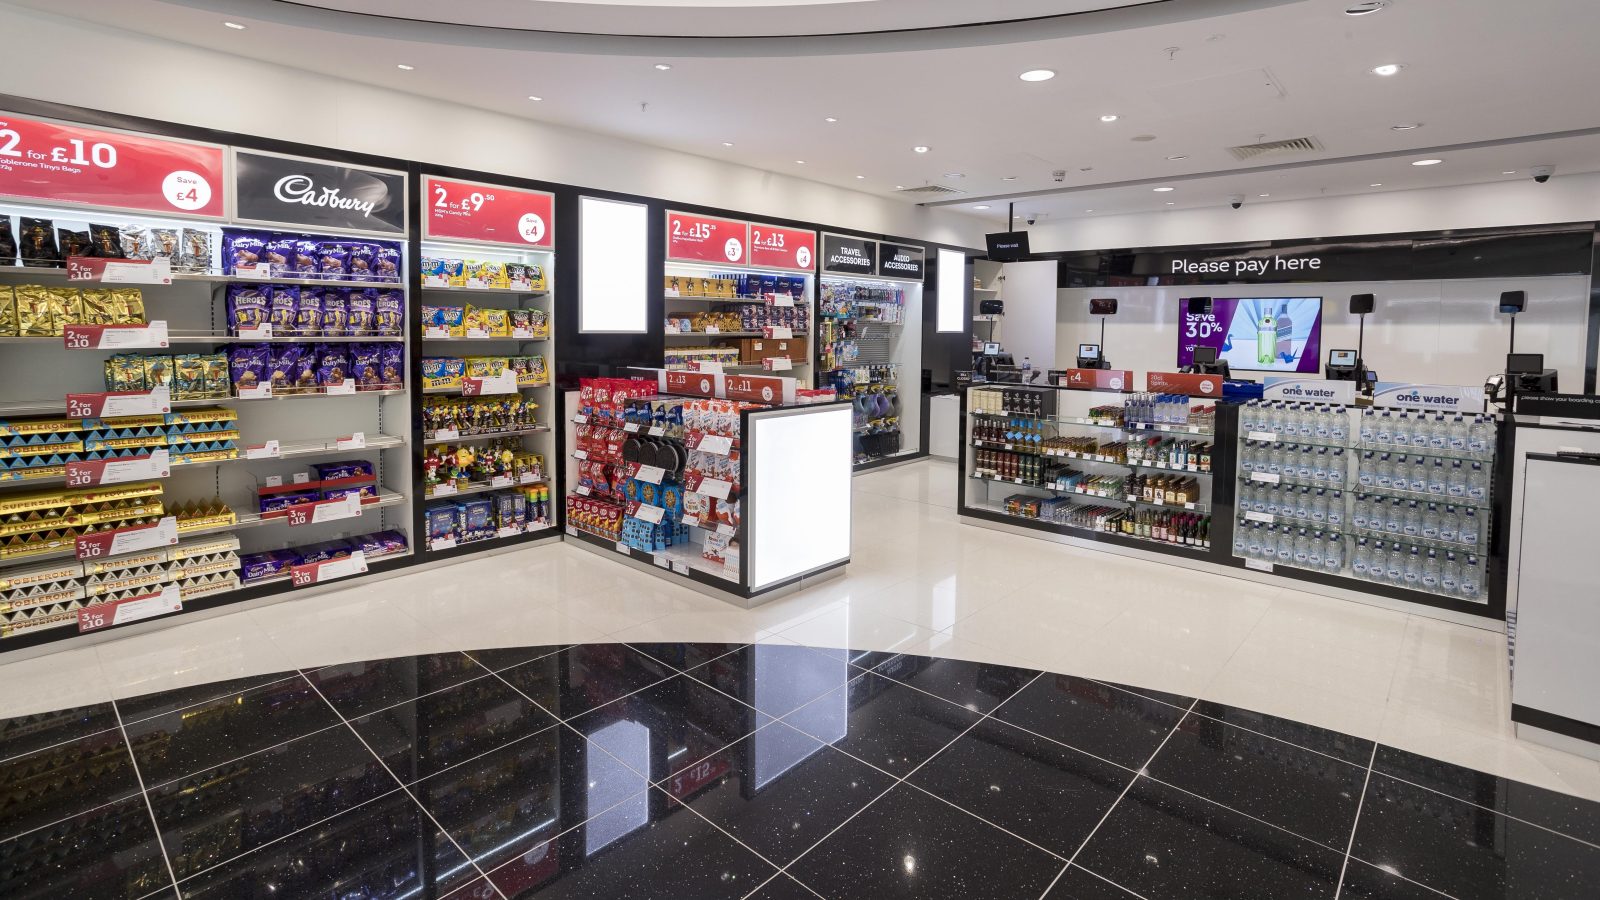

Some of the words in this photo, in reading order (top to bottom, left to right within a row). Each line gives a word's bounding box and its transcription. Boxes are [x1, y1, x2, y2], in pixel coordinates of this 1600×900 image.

[0, 129, 22, 156] 2
[27, 150, 48, 160] for
[51, 139, 117, 168] £10
[40, 162, 60, 171] Tinys
[62, 166, 81, 174] Bags
[176, 188, 198, 202] £4
[273, 174, 376, 218] Cadbury
[435, 188, 448, 208] 2
[526, 226, 538, 236] £4
[673, 220, 680, 235] 2
[754, 230, 760, 244] 2
[767, 232, 784, 248] £13
[840, 247, 861, 256] TRAVEL
[830, 255, 870, 266] ACCESSORIES
[894, 254, 910, 262] AUDIO
[70, 263, 78, 272] 2
[884, 262, 918, 271] ACCESSORIES
[1172, 259, 1230, 274] Please
[1236, 259, 1270, 276] pay
[1275, 256, 1321, 270] here
[71, 271, 92, 280] £10
[236, 296, 266, 305] HEROES
[1186, 322, 1222, 338] 30%
[68, 331, 76, 340] 2
[68, 339, 89, 348] £10
[670, 374, 674, 383] 2
[1070, 372, 1082, 382] £4
[728, 380, 734, 391] 2
[1282, 388, 1302, 396] one
[1305, 389, 1335, 397] water
[1396, 394, 1420, 402] one
[1423, 396, 1460, 404] water
[70, 400, 78, 409] 2
[70, 408, 92, 416] £10
[70, 468, 78, 477] 3
[70, 476, 92, 486] £10
[2, 498, 65, 510] SUPERSTAR
[291, 516, 306, 524] £10
[12, 522, 40, 531] LOVE
[80, 548, 100, 558] £10
[101, 556, 159, 570] TOBLERONE
[7, 570, 75, 584] TOBLERONE
[102, 575, 160, 588] TOBLERONE
[296, 576, 310, 584] £10
[8, 591, 76, 608] TOBLERONE
[82, 613, 90, 621] 3
[83, 619, 104, 630] £10
